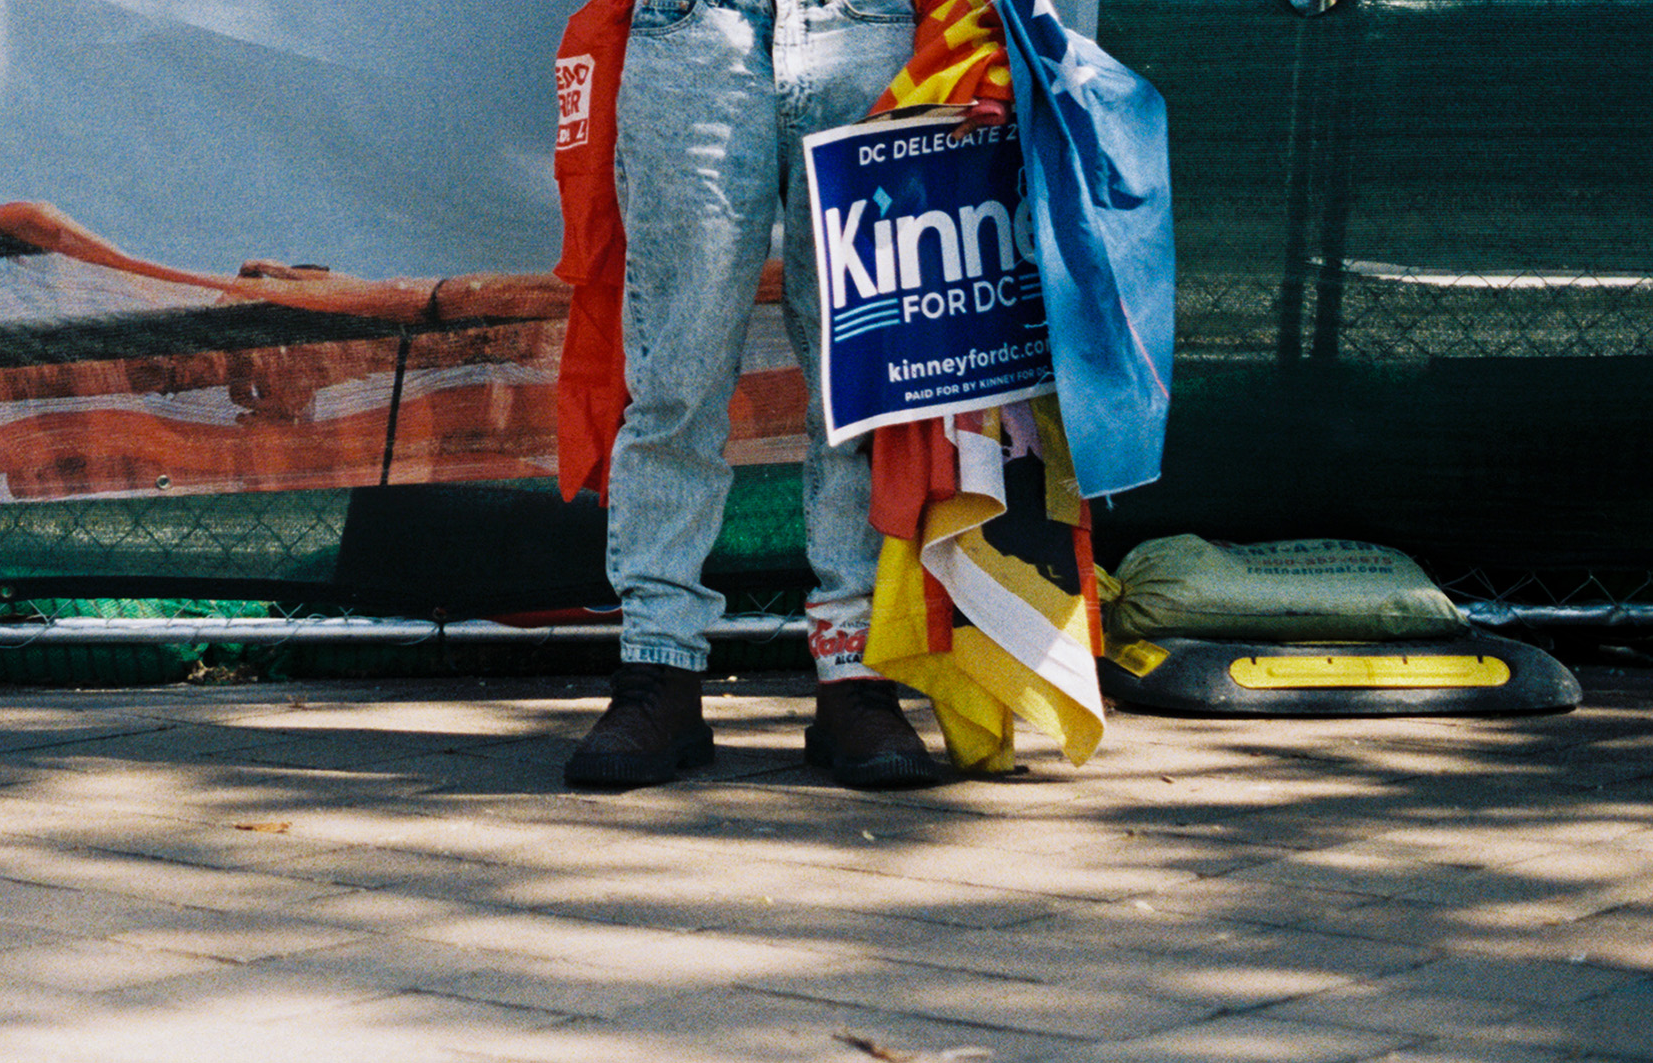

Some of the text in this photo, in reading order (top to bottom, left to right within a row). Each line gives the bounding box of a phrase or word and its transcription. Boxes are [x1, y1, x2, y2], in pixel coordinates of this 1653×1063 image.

[858, 143, 887, 166] DC
[892, 125, 1001, 160] DELEGATE
[902, 275, 1018, 323] FOR DC
[904, 389, 934, 403] PAID
[935, 384, 960, 397] FOR
[962, 381, 977, 392] BY
[979, 373, 1016, 389] KINNEY
[1017, 368, 1035, 381] FOR
[835, 653, 862, 666] ALCA
